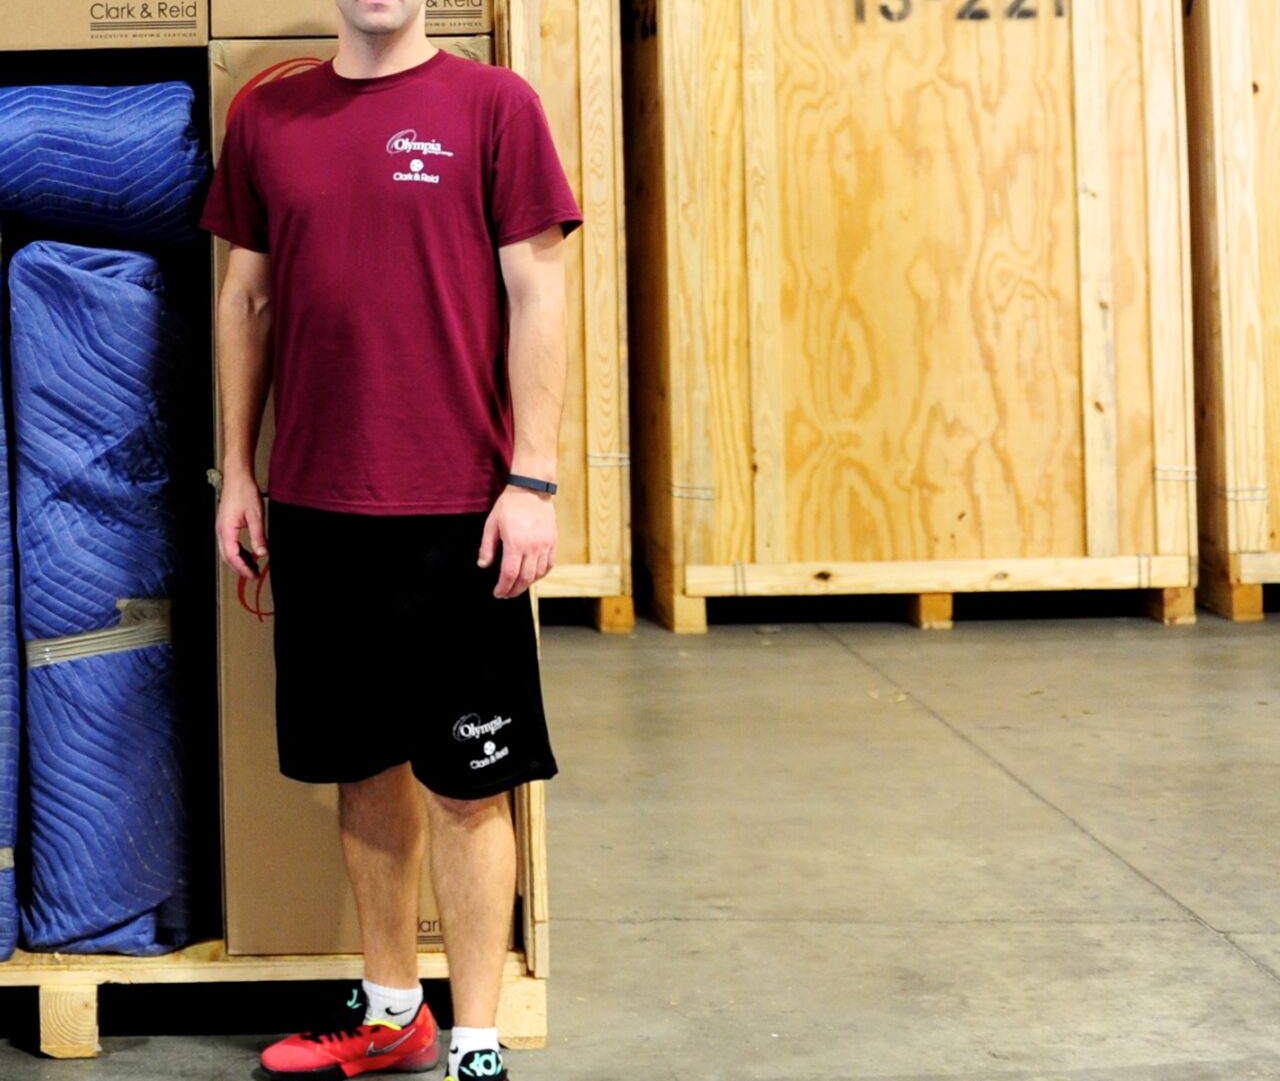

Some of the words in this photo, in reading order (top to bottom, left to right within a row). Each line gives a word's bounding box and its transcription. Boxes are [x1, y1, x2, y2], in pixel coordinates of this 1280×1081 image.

[90, 2, 136, 20] Clark
[140, 2, 152, 19] &
[158, 1, 197, 18] Reid
[394, 137, 442, 156] Olympia
